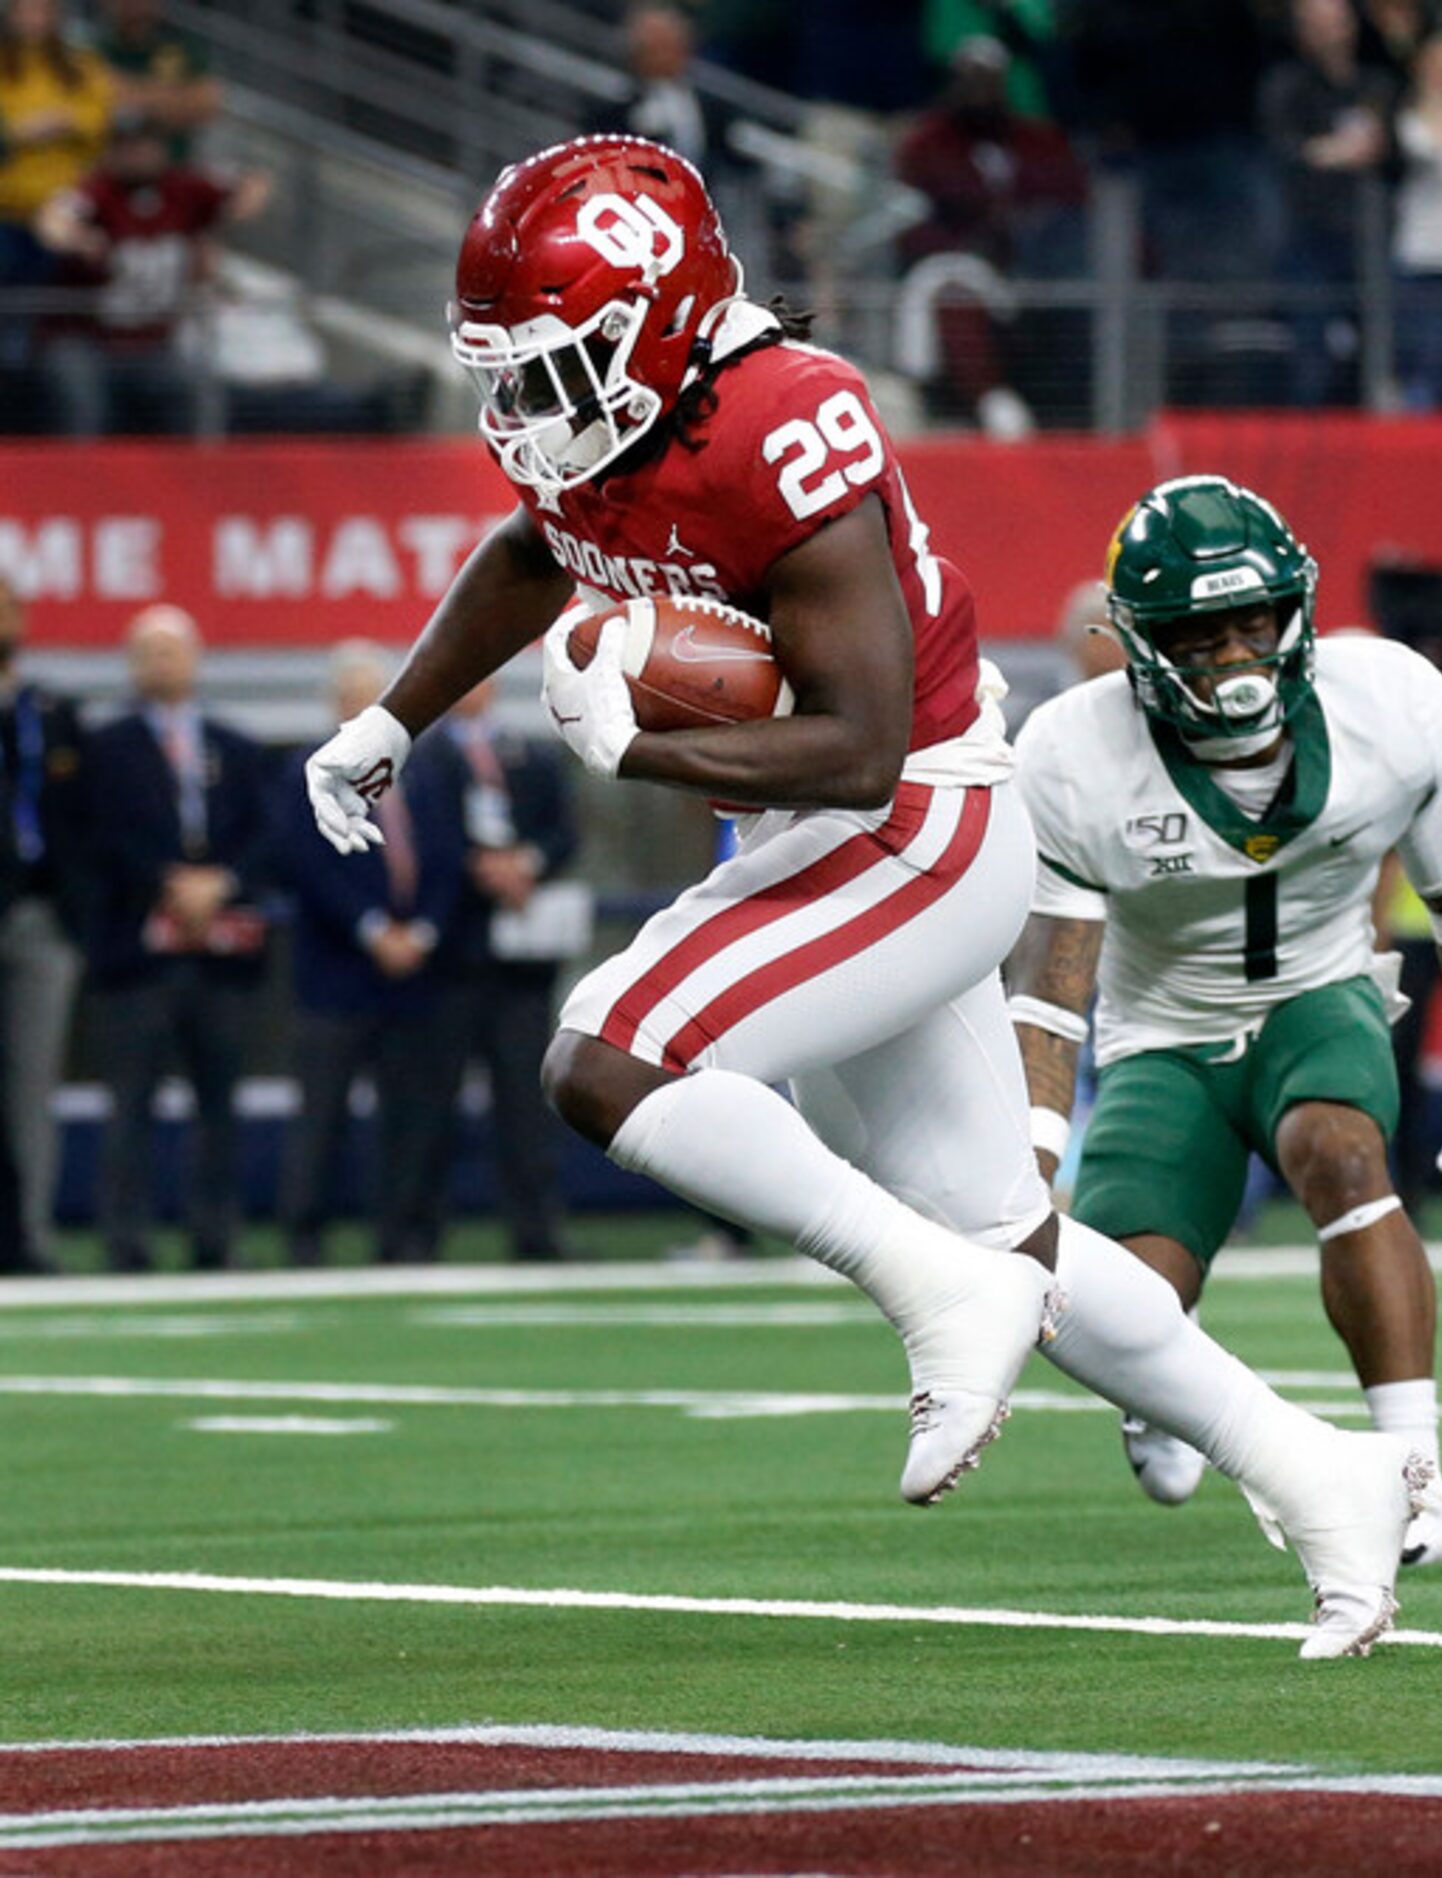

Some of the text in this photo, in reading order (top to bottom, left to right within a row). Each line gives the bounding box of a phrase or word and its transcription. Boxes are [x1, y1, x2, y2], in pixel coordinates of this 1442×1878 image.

[762, 390, 885, 521] 29
[212, 514, 505, 600] MAT
[543, 520, 728, 602] SOONERS
[1243, 870, 1279, 983] 1
